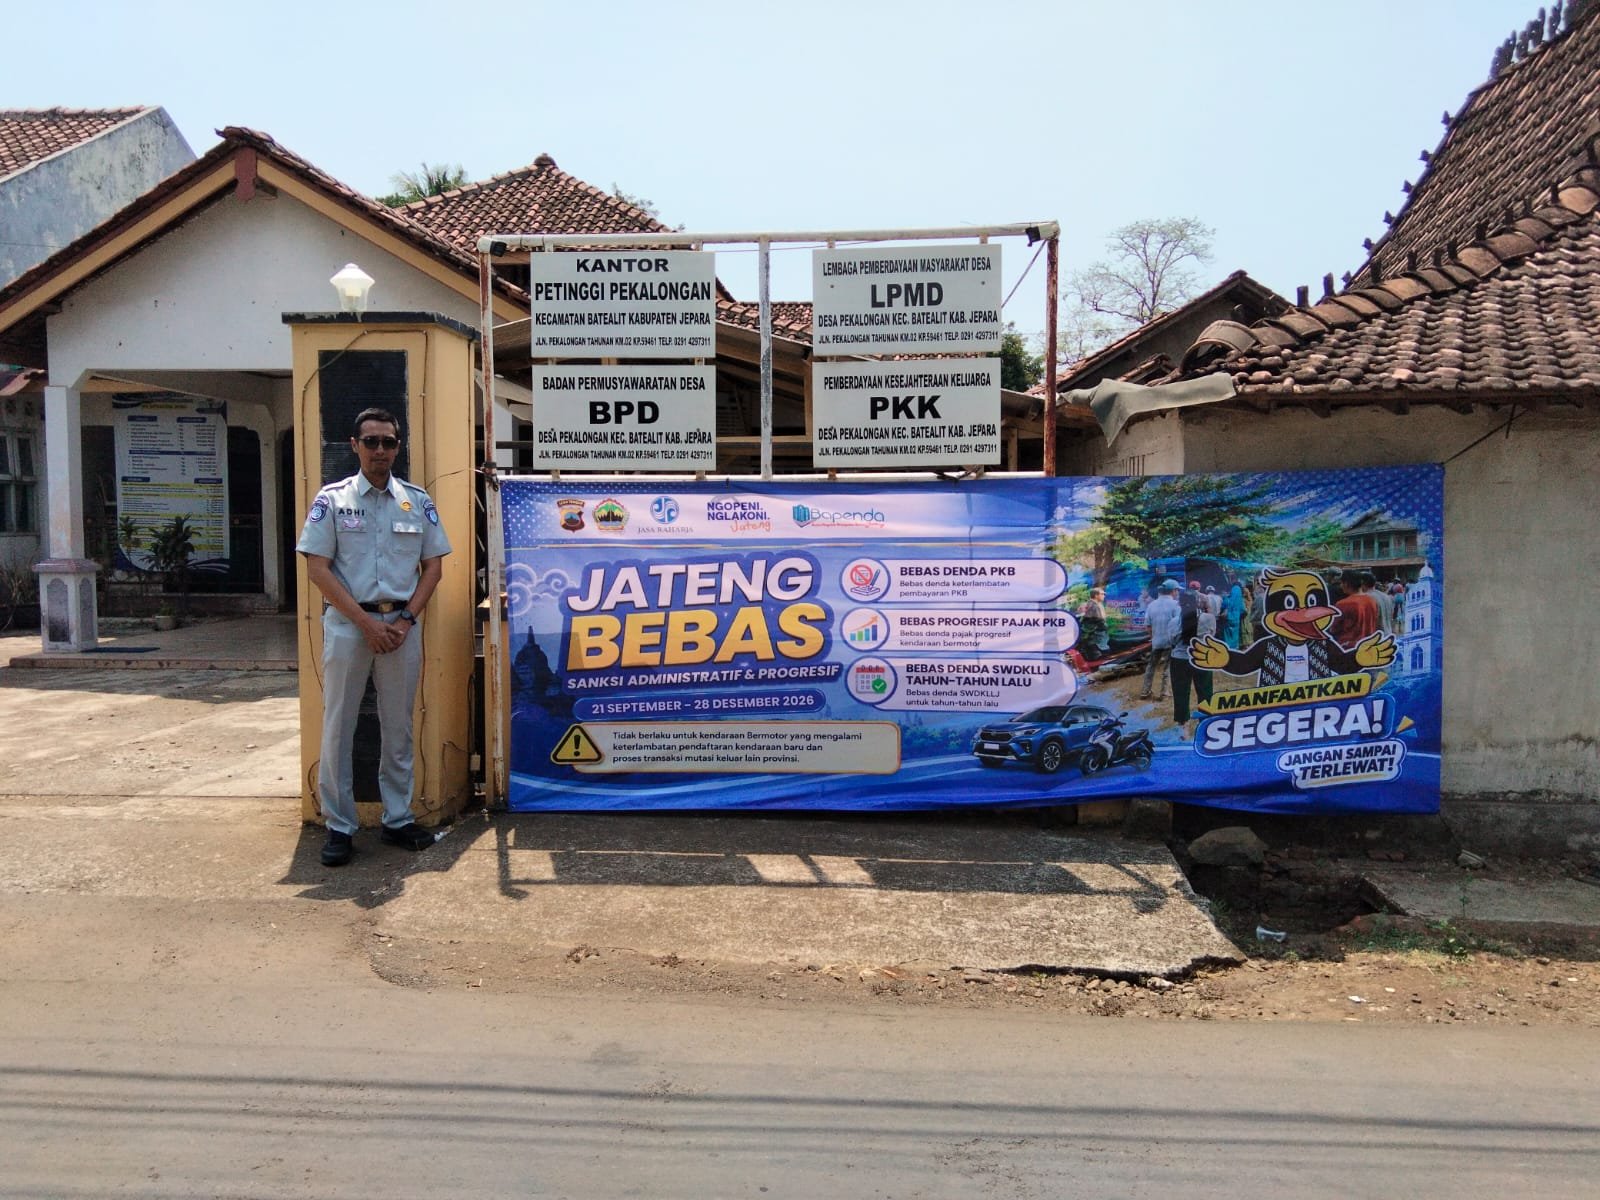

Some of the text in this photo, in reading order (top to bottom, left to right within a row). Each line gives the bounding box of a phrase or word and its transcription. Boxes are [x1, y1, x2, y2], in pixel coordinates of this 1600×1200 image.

[576, 258, 670, 272] KANTOR
[822, 256, 991, 276] LEMBAGA PEMBERDAYAAN MASYARAKAT DESA
[535, 282, 711, 301] PETINGGI PEKALONGAN
[871, 282, 944, 308] LPMD
[535, 312, 710, 326] KECAMATAN BATEALIT KABUPATEN JEPARA
[818, 310, 998, 328] DESA PEKALONGAN KEC. BATEALIT KAB. JEPARA
[535, 337, 548, 346] JLN.
[549, 337, 586, 346] PEKALONGAN
[586, 337, 614, 346] TAHUNAN
[614, 337, 632, 346] KM.02
[658, 336, 672, 346] TELP.
[674, 336, 686, 346] 0291
[688, 336, 711, 346] 4297311
[818, 334, 831, 344] JLN.
[832, 334, 870, 343] PEKALONGAN
[871, 333, 899, 342] TAHUNAN
[900, 332, 917, 342] KM.02
[944, 332, 959, 341] TELP.
[960, 331, 974, 341] 0291
[975, 331, 998, 340] 4297311
[542, 376, 706, 390] BADAN PERMUSYAWARATAN DESA
[824, 372, 991, 390] PEMBERDAYAAN KESEJAHTERAAN KELUARGA
[589, 401, 660, 425] BPD
[870, 395, 942, 420] PKK
[538, 431, 712, 444] DESA PEKALONGAN KEC. BATEALIT KAB. JEPARA
[818, 424, 996, 441] DESA PEKALONGAN KEC. BATEALIT KAB. JEPARA
[538, 450, 551, 459] JLN.
[552, 450, 589, 459] PEKALONGAN
[590, 450, 617, 459] TAHUNAN
[618, 450, 634, 459] KM.02
[661, 450, 675, 459] TELP.
[676, 450, 689, 459] 0291
[690, 450, 713, 459] 4297311
[818, 447, 831, 456] JLN.
[832, 447, 870, 456] PEKALONGAN
[871, 446, 898, 455] TAHUNAN
[900, 446, 916, 455] KM.02
[944, 445, 958, 454] TELP.
[959, 444, 972, 454] 0291
[974, 444, 997, 453] 4297311
[338, 508, 365, 516] ADHI
[707, 502, 764, 511] NGOPENI.
[707, 511, 770, 520] NGLAKONI.
[810, 508, 885, 523] Bapenda
[638, 526, 694, 534] JASA RAHARJA
[730, 520, 772, 532] Jateng
[900, 566, 1016, 576] BEBAS DENDA PKB
[567, 557, 813, 612] JATENG
[900, 589, 968, 598] pembayaran PKB
[900, 617, 1066, 628] BEBAS PROGRESIF PAJAK PKB
[566, 602, 826, 672] BEBAS
[952, 630, 974, 639] pajak
[975, 630, 1012, 639] progresif
[906, 664, 1050, 675] BEBAS DENDA SWDKLLJ
[567, 664, 840, 689] SANKSI ADMINISTRATIF & PROGRESIF
[906, 676, 1032, 687] TAHUN-TAHUN LALU
[906, 688, 930, 696] Bebas
[960, 690, 1000, 698] SWDKLLJ
[1217, 678, 1362, 710] MANFAATKAN
[592, 704, 605, 714] 21
[607, 701, 682, 713] SEPTEMBER
[694, 700, 710, 710] 28
[712, 696, 780, 709] DESEMBER
[782, 695, 815, 706] 2026
[906, 698, 999, 707] untuk tahun-tahun lalu
[1203, 699, 1385, 750] SEGERA!
[613, 731, 862, 742] Tidak berlaku untuk kendaraan Bermotor yang mengalami
[613, 742, 823, 753] keterlambatan pendaftaran kendaraan baru dan
[612, 754, 800, 764] proses transaksi mutasi keluar lain provinsi.
[1284, 744, 1396, 767] JANGAN SAMPAI
[1300, 757, 1395, 781] TERLEWAT!
